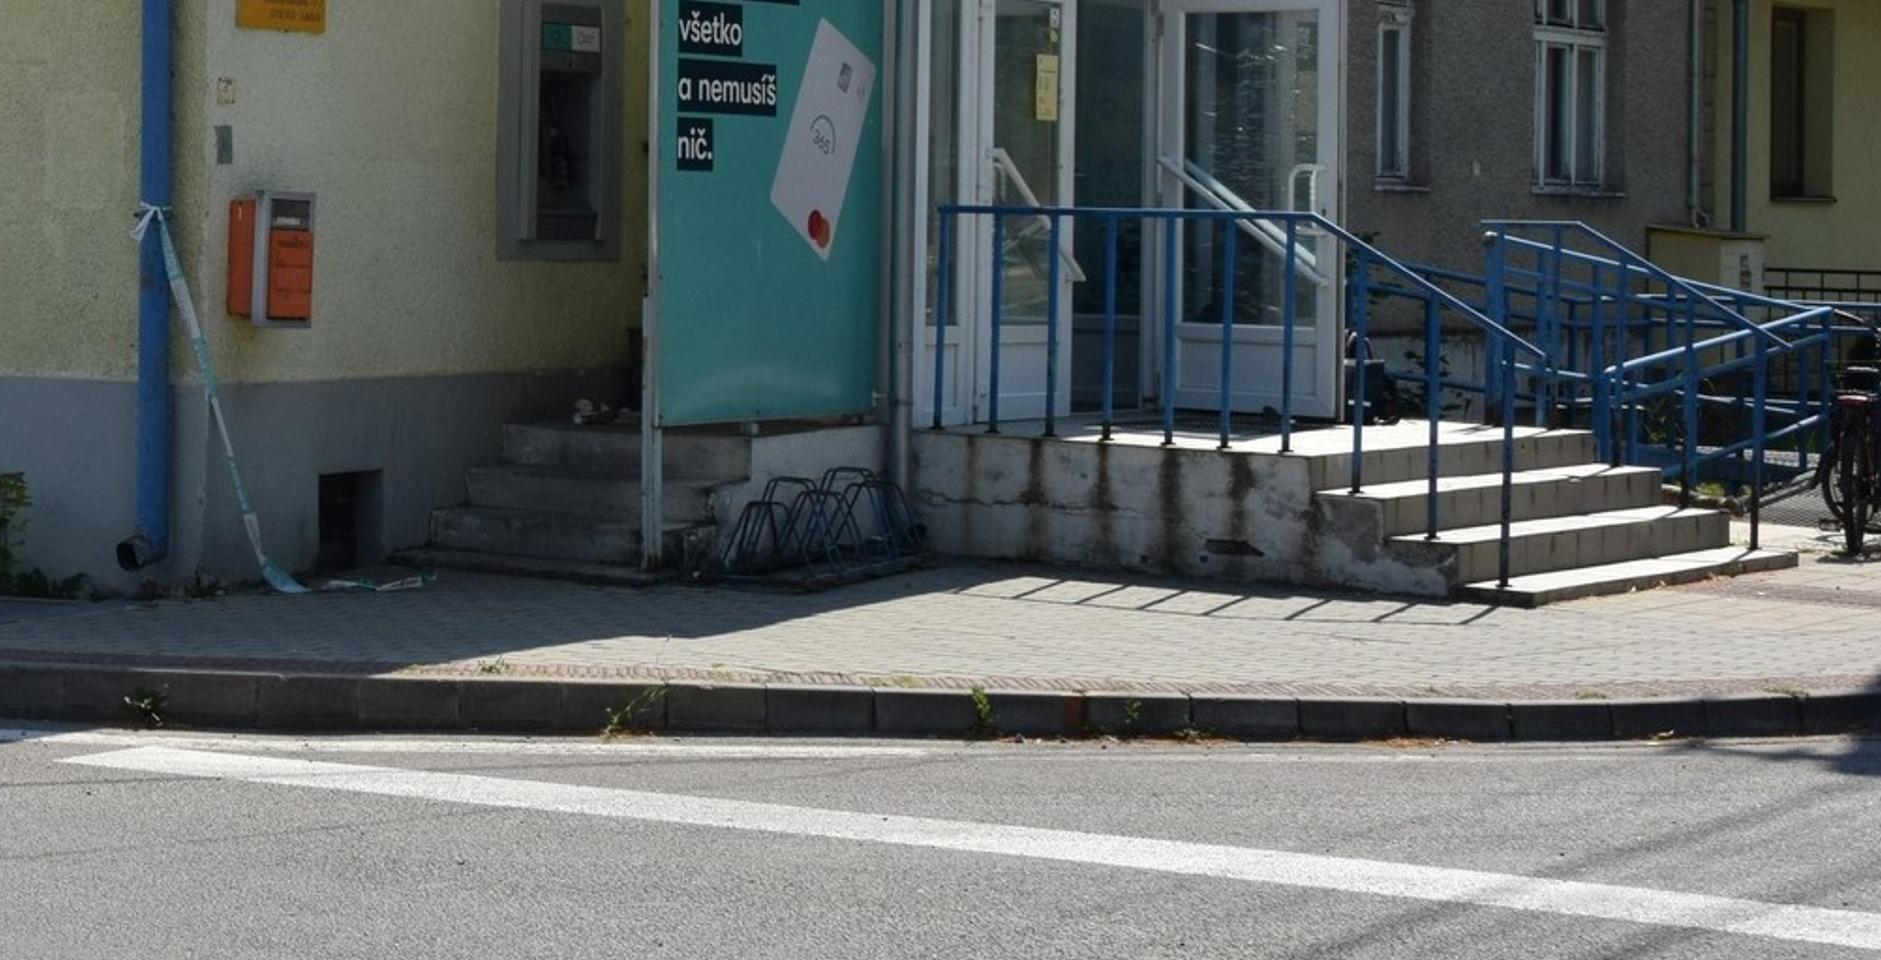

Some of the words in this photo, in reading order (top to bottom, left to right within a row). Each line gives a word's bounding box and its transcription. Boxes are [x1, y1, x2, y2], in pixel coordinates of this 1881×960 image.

[679, 11, 742, 45] všetko
[678, 77, 692, 101] a
[699, 74, 776, 105] nemusíš
[678, 128, 712, 159] nič.
